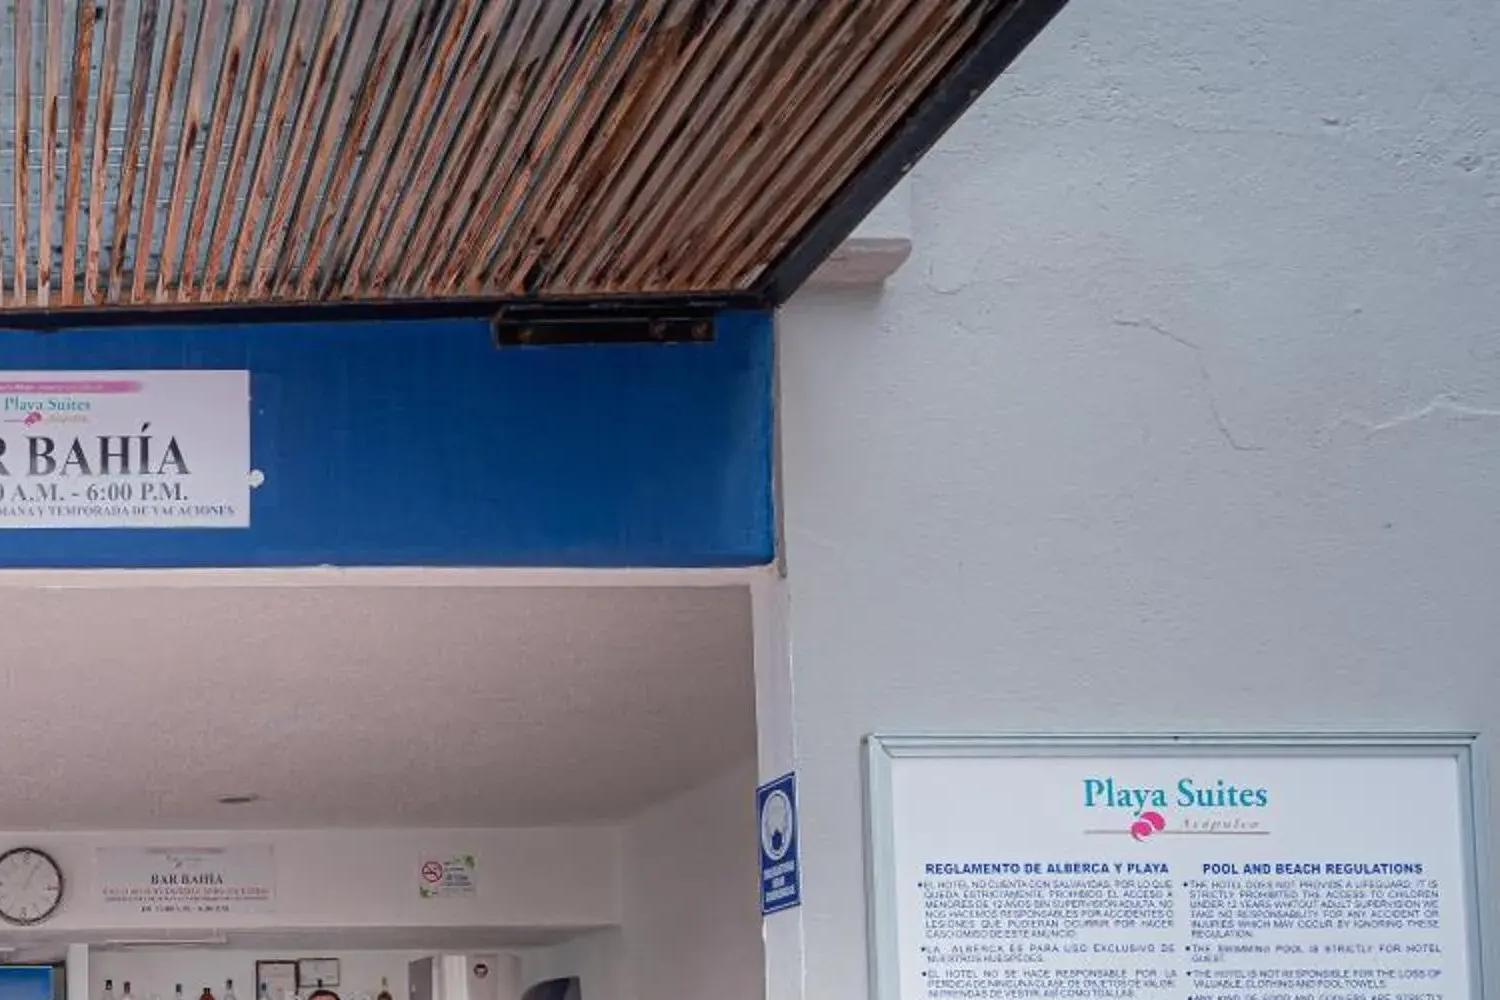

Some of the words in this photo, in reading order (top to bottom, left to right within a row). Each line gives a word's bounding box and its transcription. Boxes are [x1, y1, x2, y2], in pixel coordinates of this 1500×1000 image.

[48, 397, 91, 411] Suites
[26, 422, 191, 476] BAHÍA
[11, 482, 65, 501] A.M.
[86, 482, 133, 501] 6:00
[141, 482, 189, 501] P.M.
[151, 505, 235, 517] VACACIONES
[1082, 777, 1168, 817] Playa
[1176, 777, 1268, 807] Suites
[925, 863, 1021, 875] REGLAMENTO
[1025, 863, 1043, 875] DE
[1047, 863, 1109, 875] ALBERCA
[1114, 863, 1123, 875] Y
[1127, 863, 1169, 875] PLAYA
[1203, 863, 1239, 875] POOL
[1243, 863, 1271, 875] AND
[1275, 863, 1321, 875] BEACH
[1325, 863, 1423, 875] REGULATIONS
